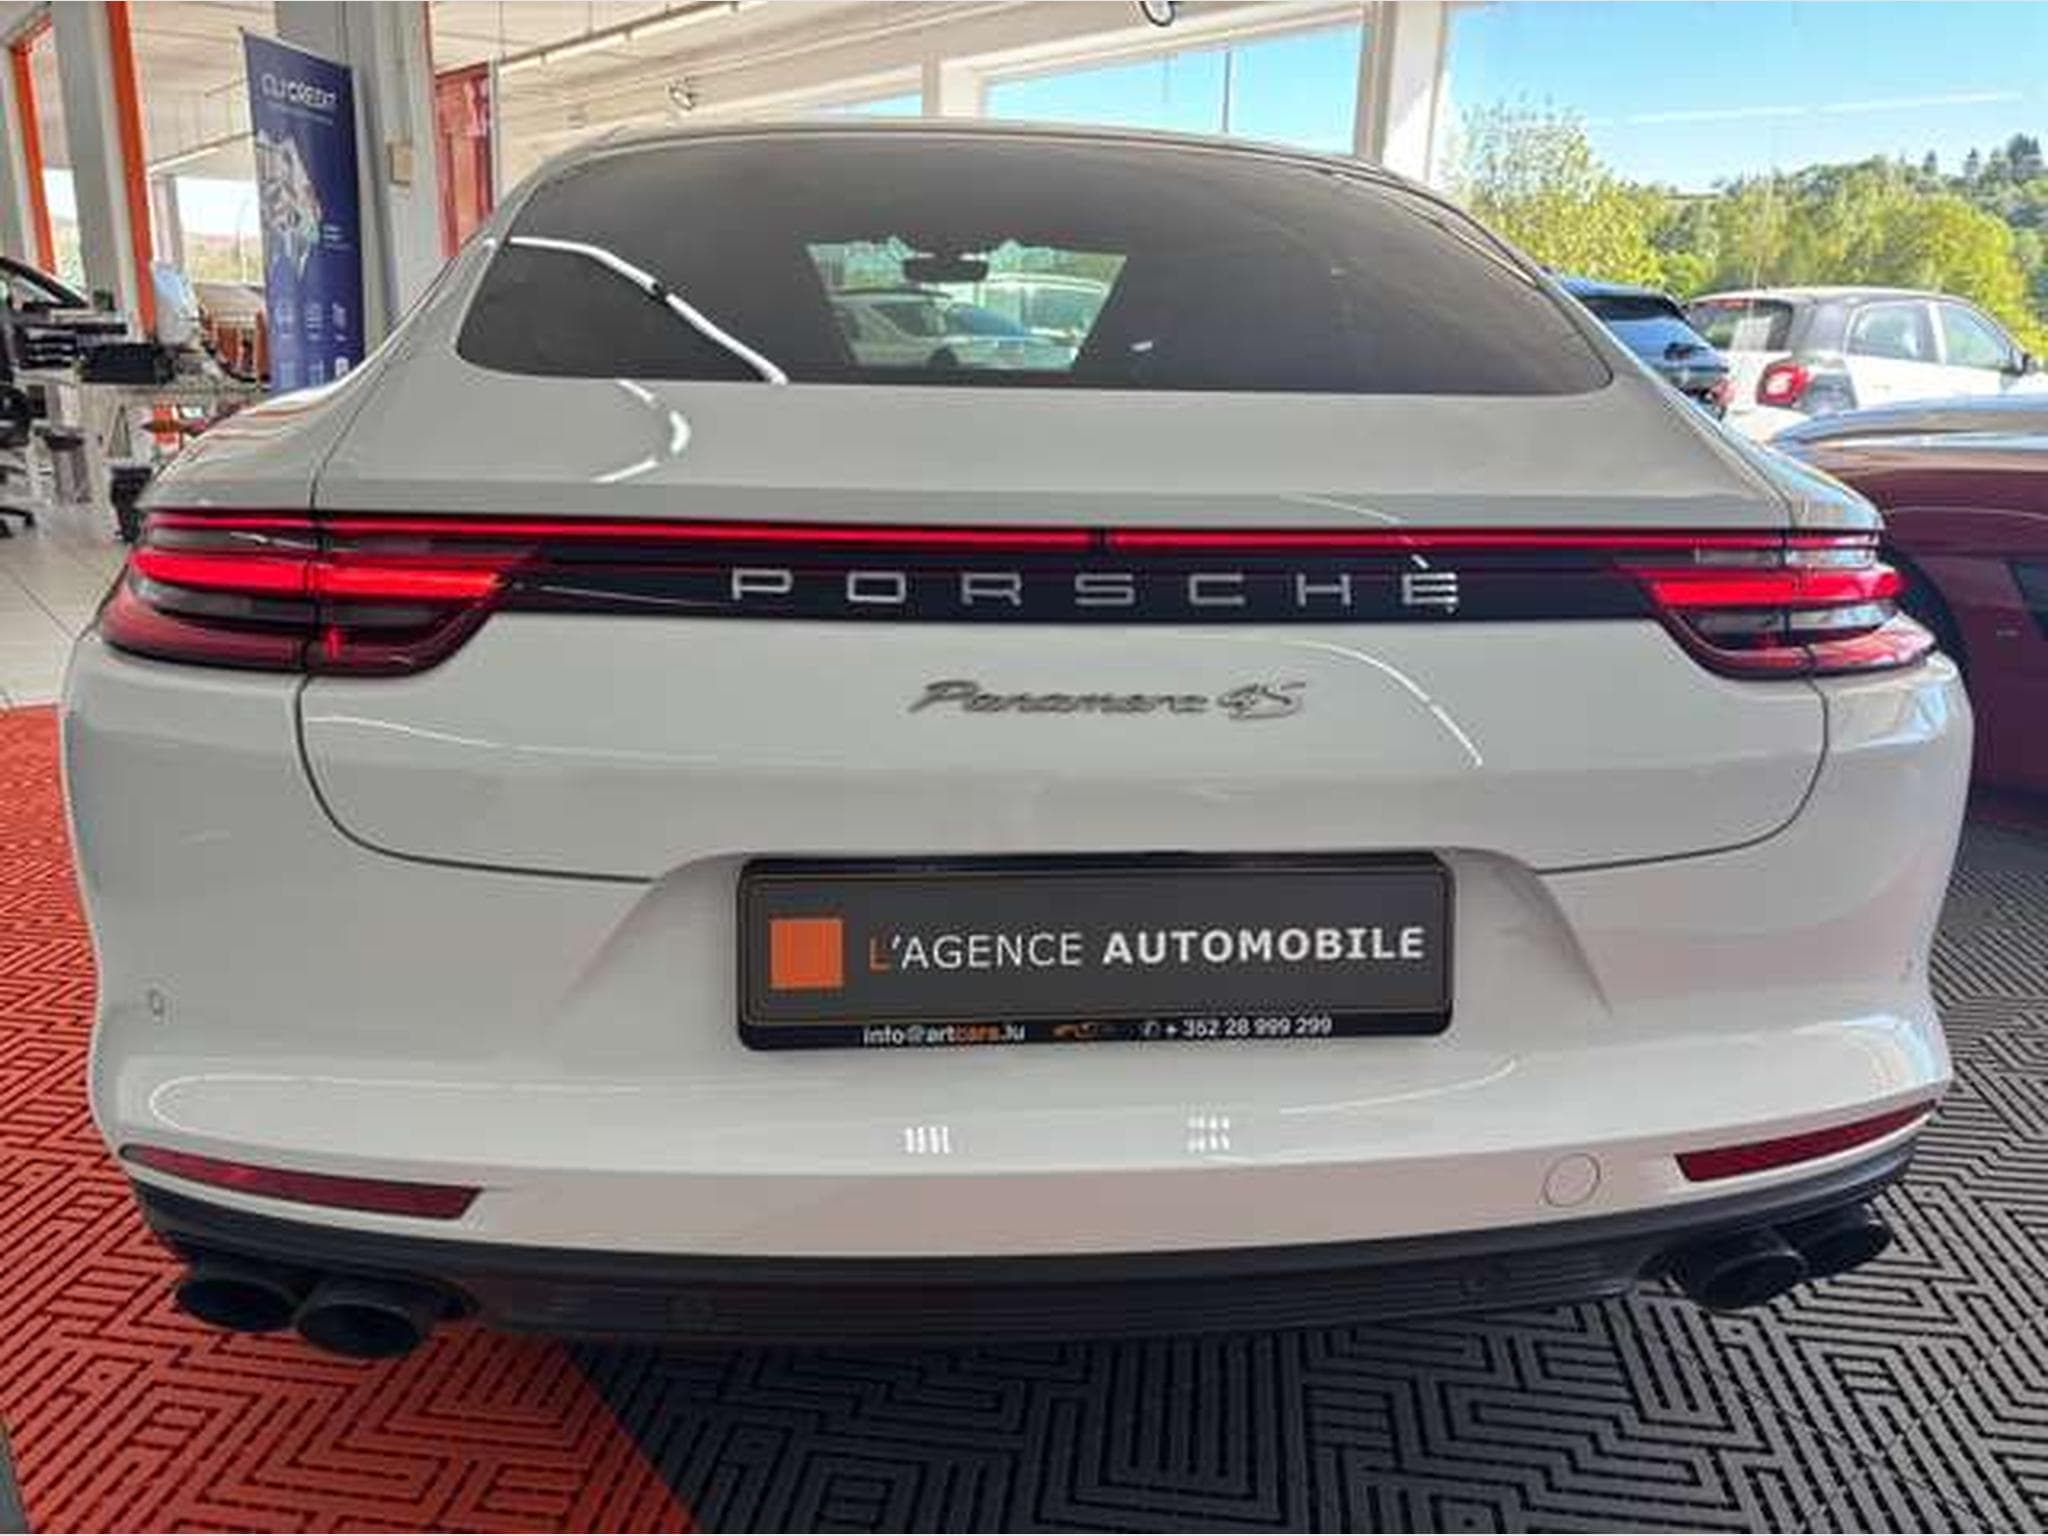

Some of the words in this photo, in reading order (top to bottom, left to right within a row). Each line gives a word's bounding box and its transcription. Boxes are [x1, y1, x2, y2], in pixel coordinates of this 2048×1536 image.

[731, 568, 1458, 606] PORSCHE
[868, 930, 1084, 973] L'AGENCE
[1102, 926, 1425, 965] AUTOMOBILE
[1224, 1017, 1250, 1036] 28
